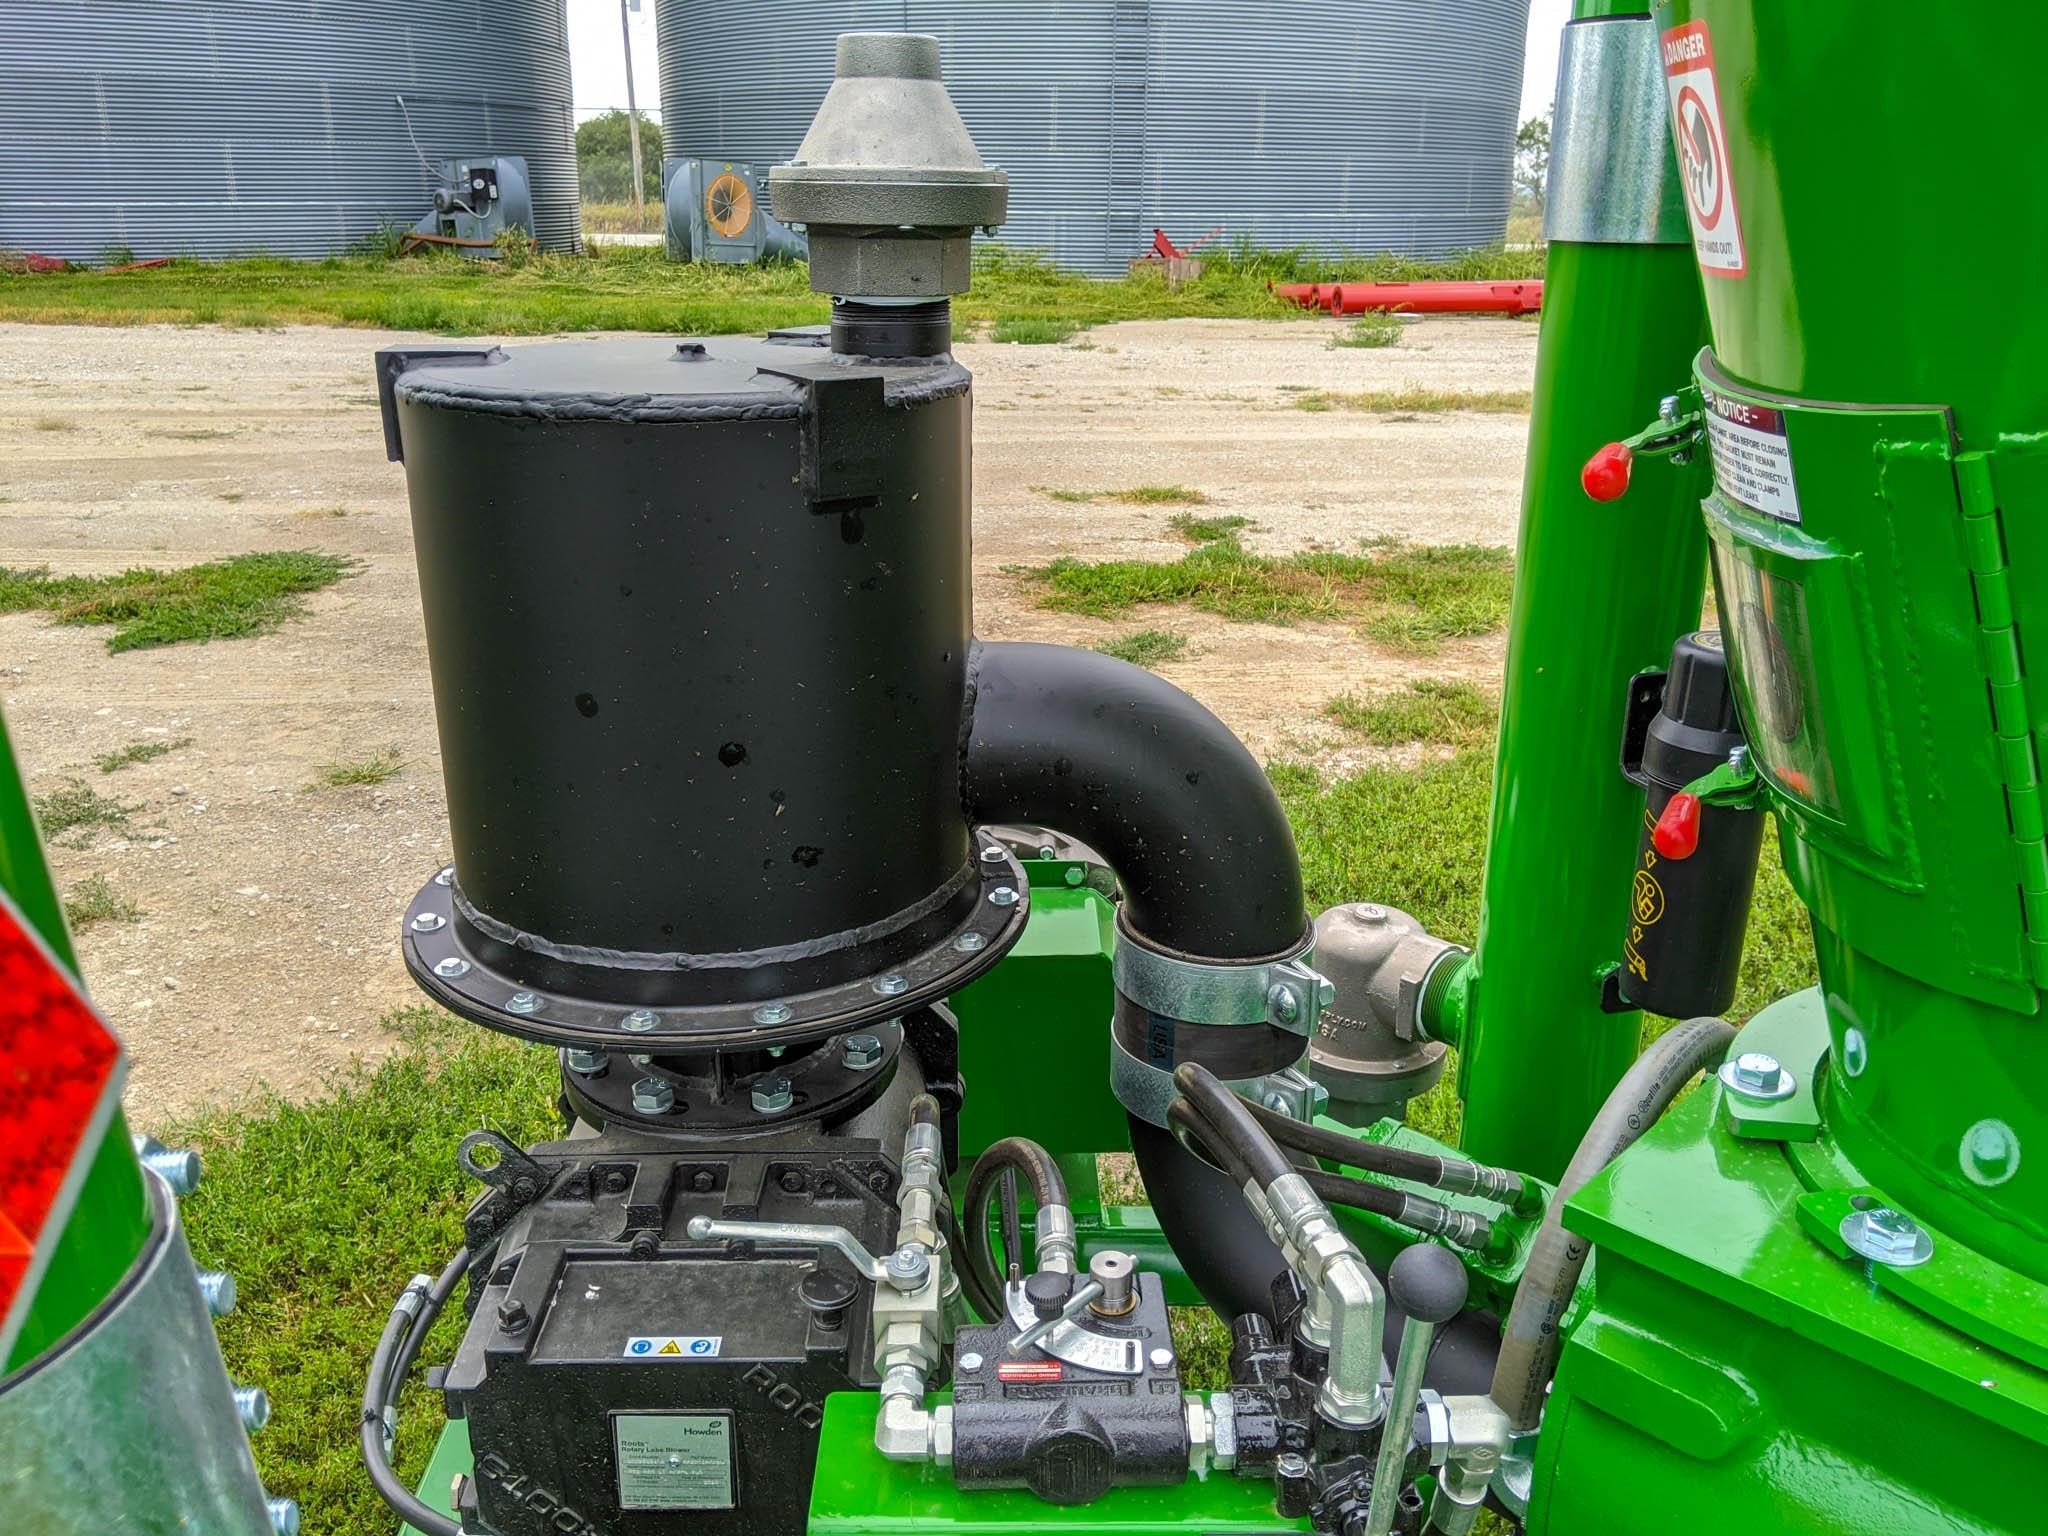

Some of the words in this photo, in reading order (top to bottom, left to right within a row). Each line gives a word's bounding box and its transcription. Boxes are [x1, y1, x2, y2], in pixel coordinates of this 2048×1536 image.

[1667, 33, 1705, 66] DANGER
[1717, 397, 1751, 424] NOTICE
[1740, 435, 1761, 451] BEFORE
[1760, 442, 1788, 458] CLOSING
[1754, 454, 1776, 469] REMAIN
[1742, 462, 1755, 476] SEAL
[1754, 468, 1790, 487] CORRECTLY.
[1757, 481, 1781, 497] CLAMPS
[1565, 1243, 1581, 1262] CE
[683, 1427, 723, 1437] Howden
